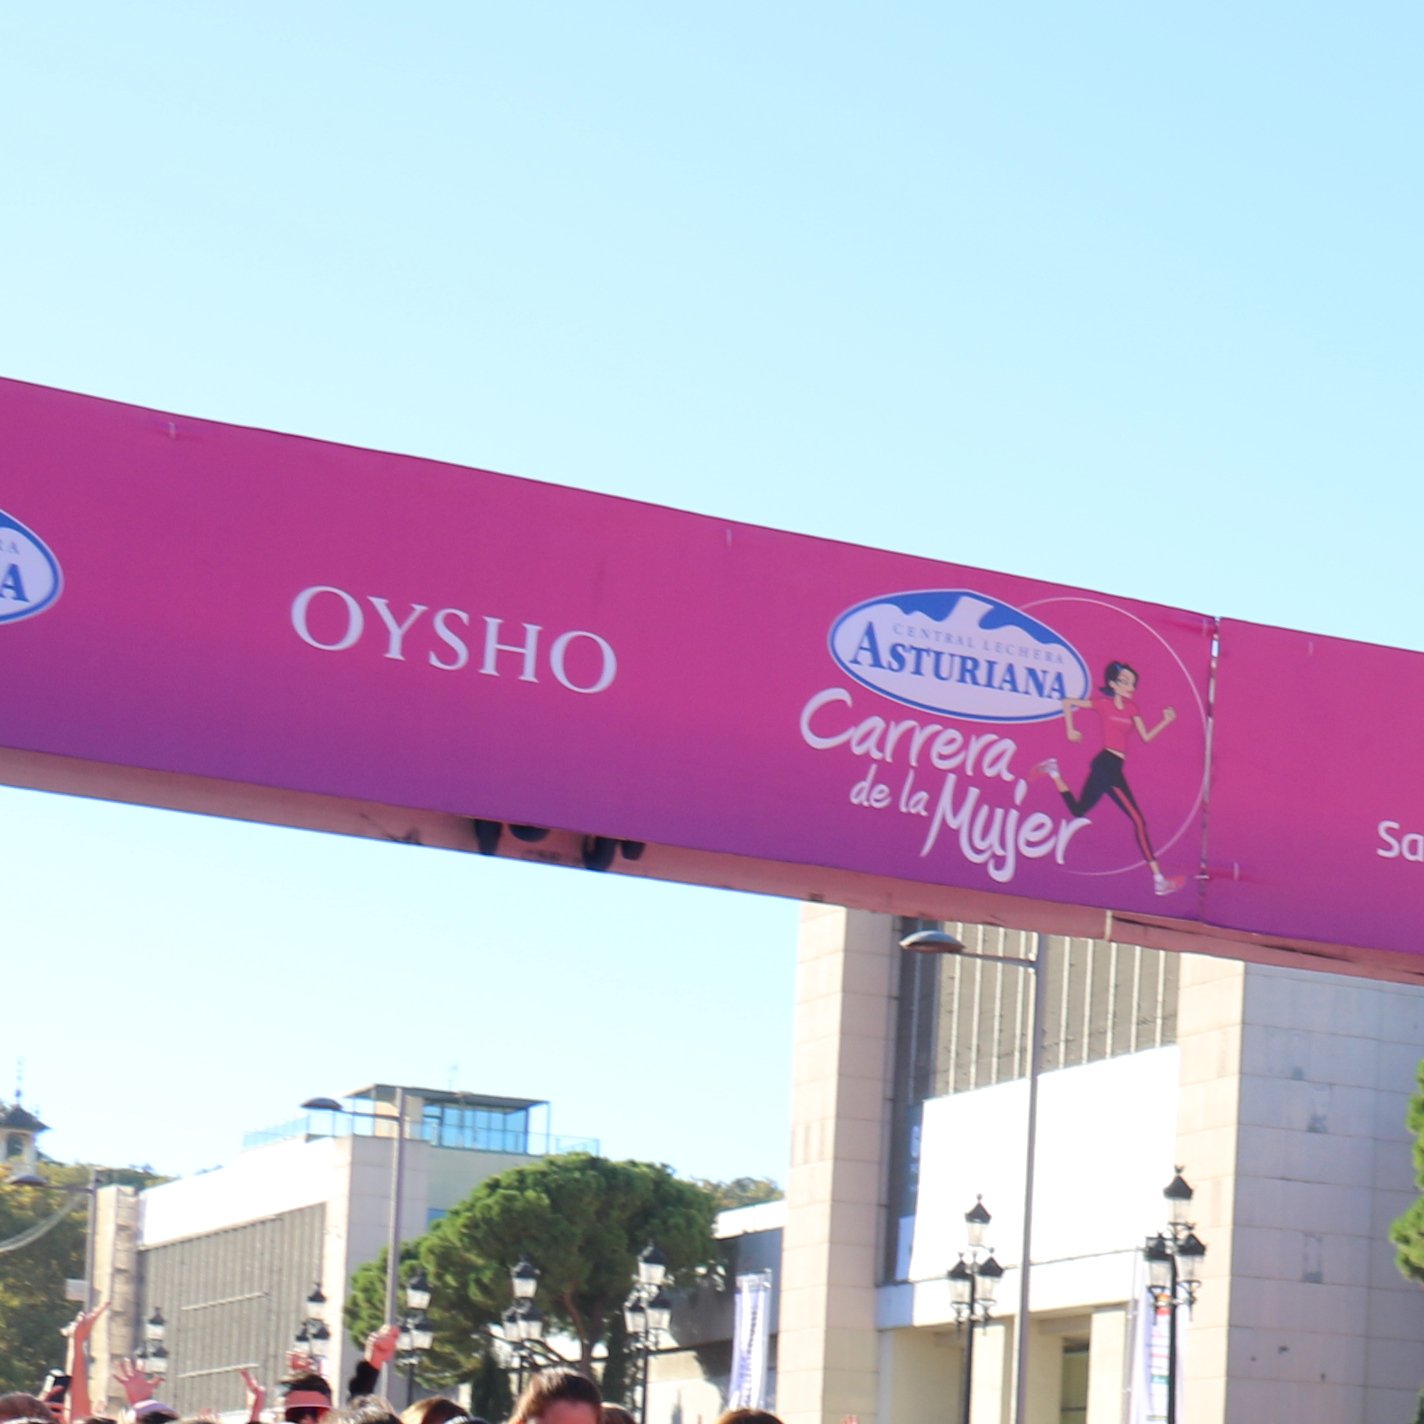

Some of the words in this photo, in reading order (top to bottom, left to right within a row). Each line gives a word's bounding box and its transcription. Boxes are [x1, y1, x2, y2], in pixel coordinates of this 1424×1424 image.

[290, 585, 618, 694] OYSHO
[849, 621, 1067, 700] ASTURIANA
[892, 623, 975, 649] CENTRAL
[984, 640, 1064, 664] LECHERA
[800, 687, 1014, 784] Carrera
[850, 763, 892, 809] de
[900, 768, 929, 817] la
[920, 773, 1092, 883] Mujer
